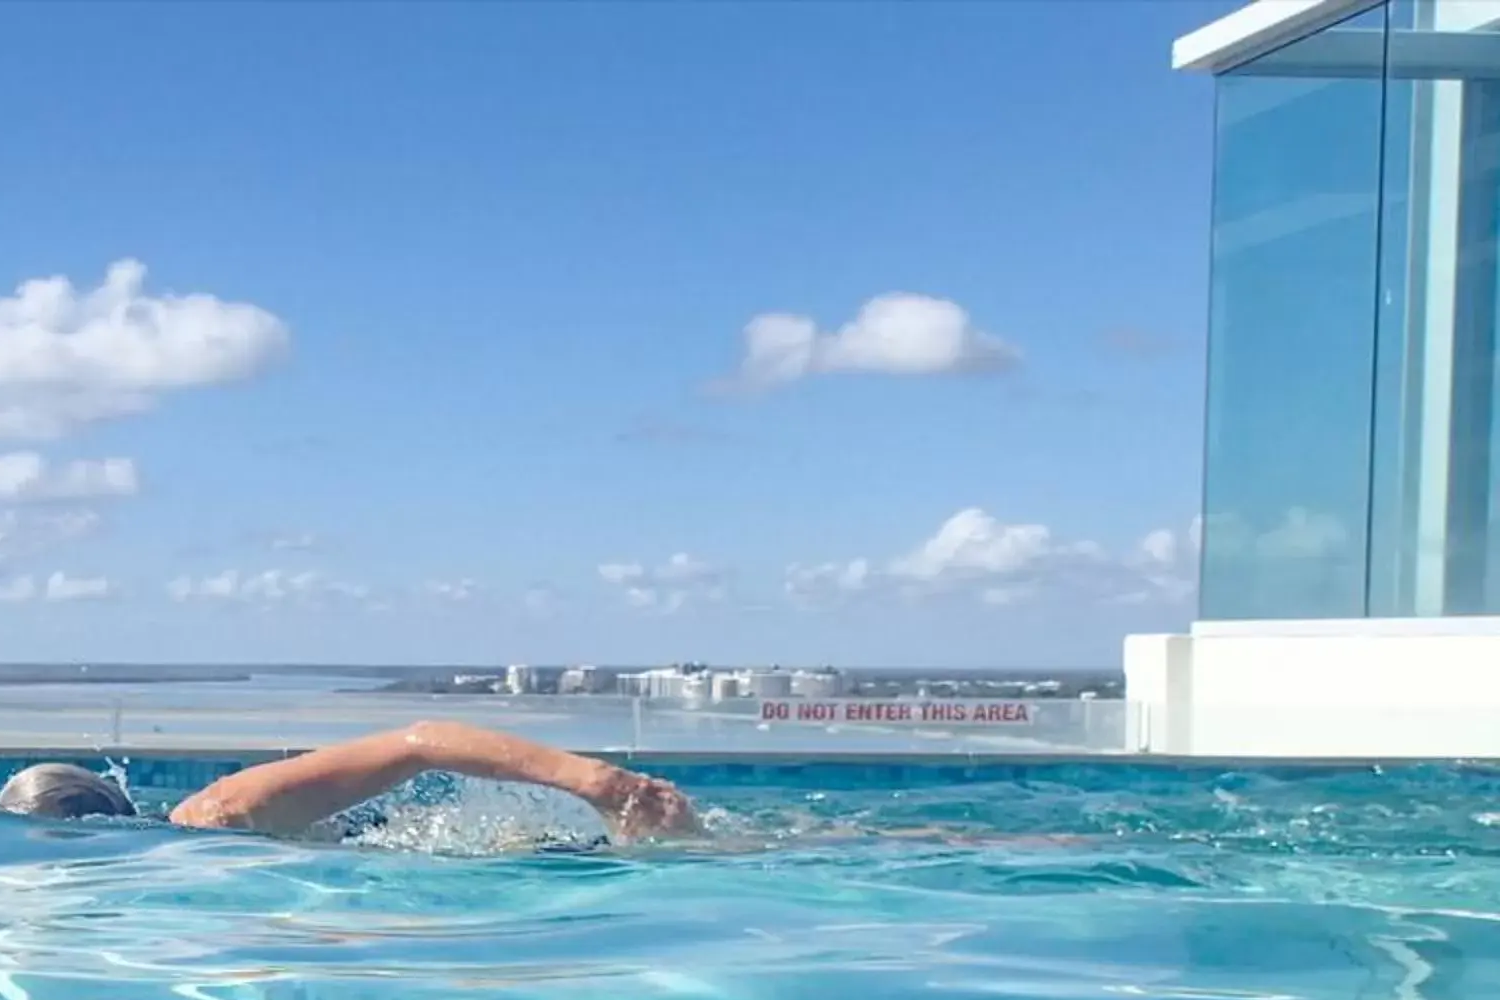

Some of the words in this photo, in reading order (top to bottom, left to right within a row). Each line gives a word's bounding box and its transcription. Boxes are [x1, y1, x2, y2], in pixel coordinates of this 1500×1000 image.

[762, 702, 789, 720] DO
[797, 702, 837, 720] NOT
[846, 703, 911, 721] ENTER
[921, 702, 967, 721] THIS
[973, 703, 1029, 721] AREA
